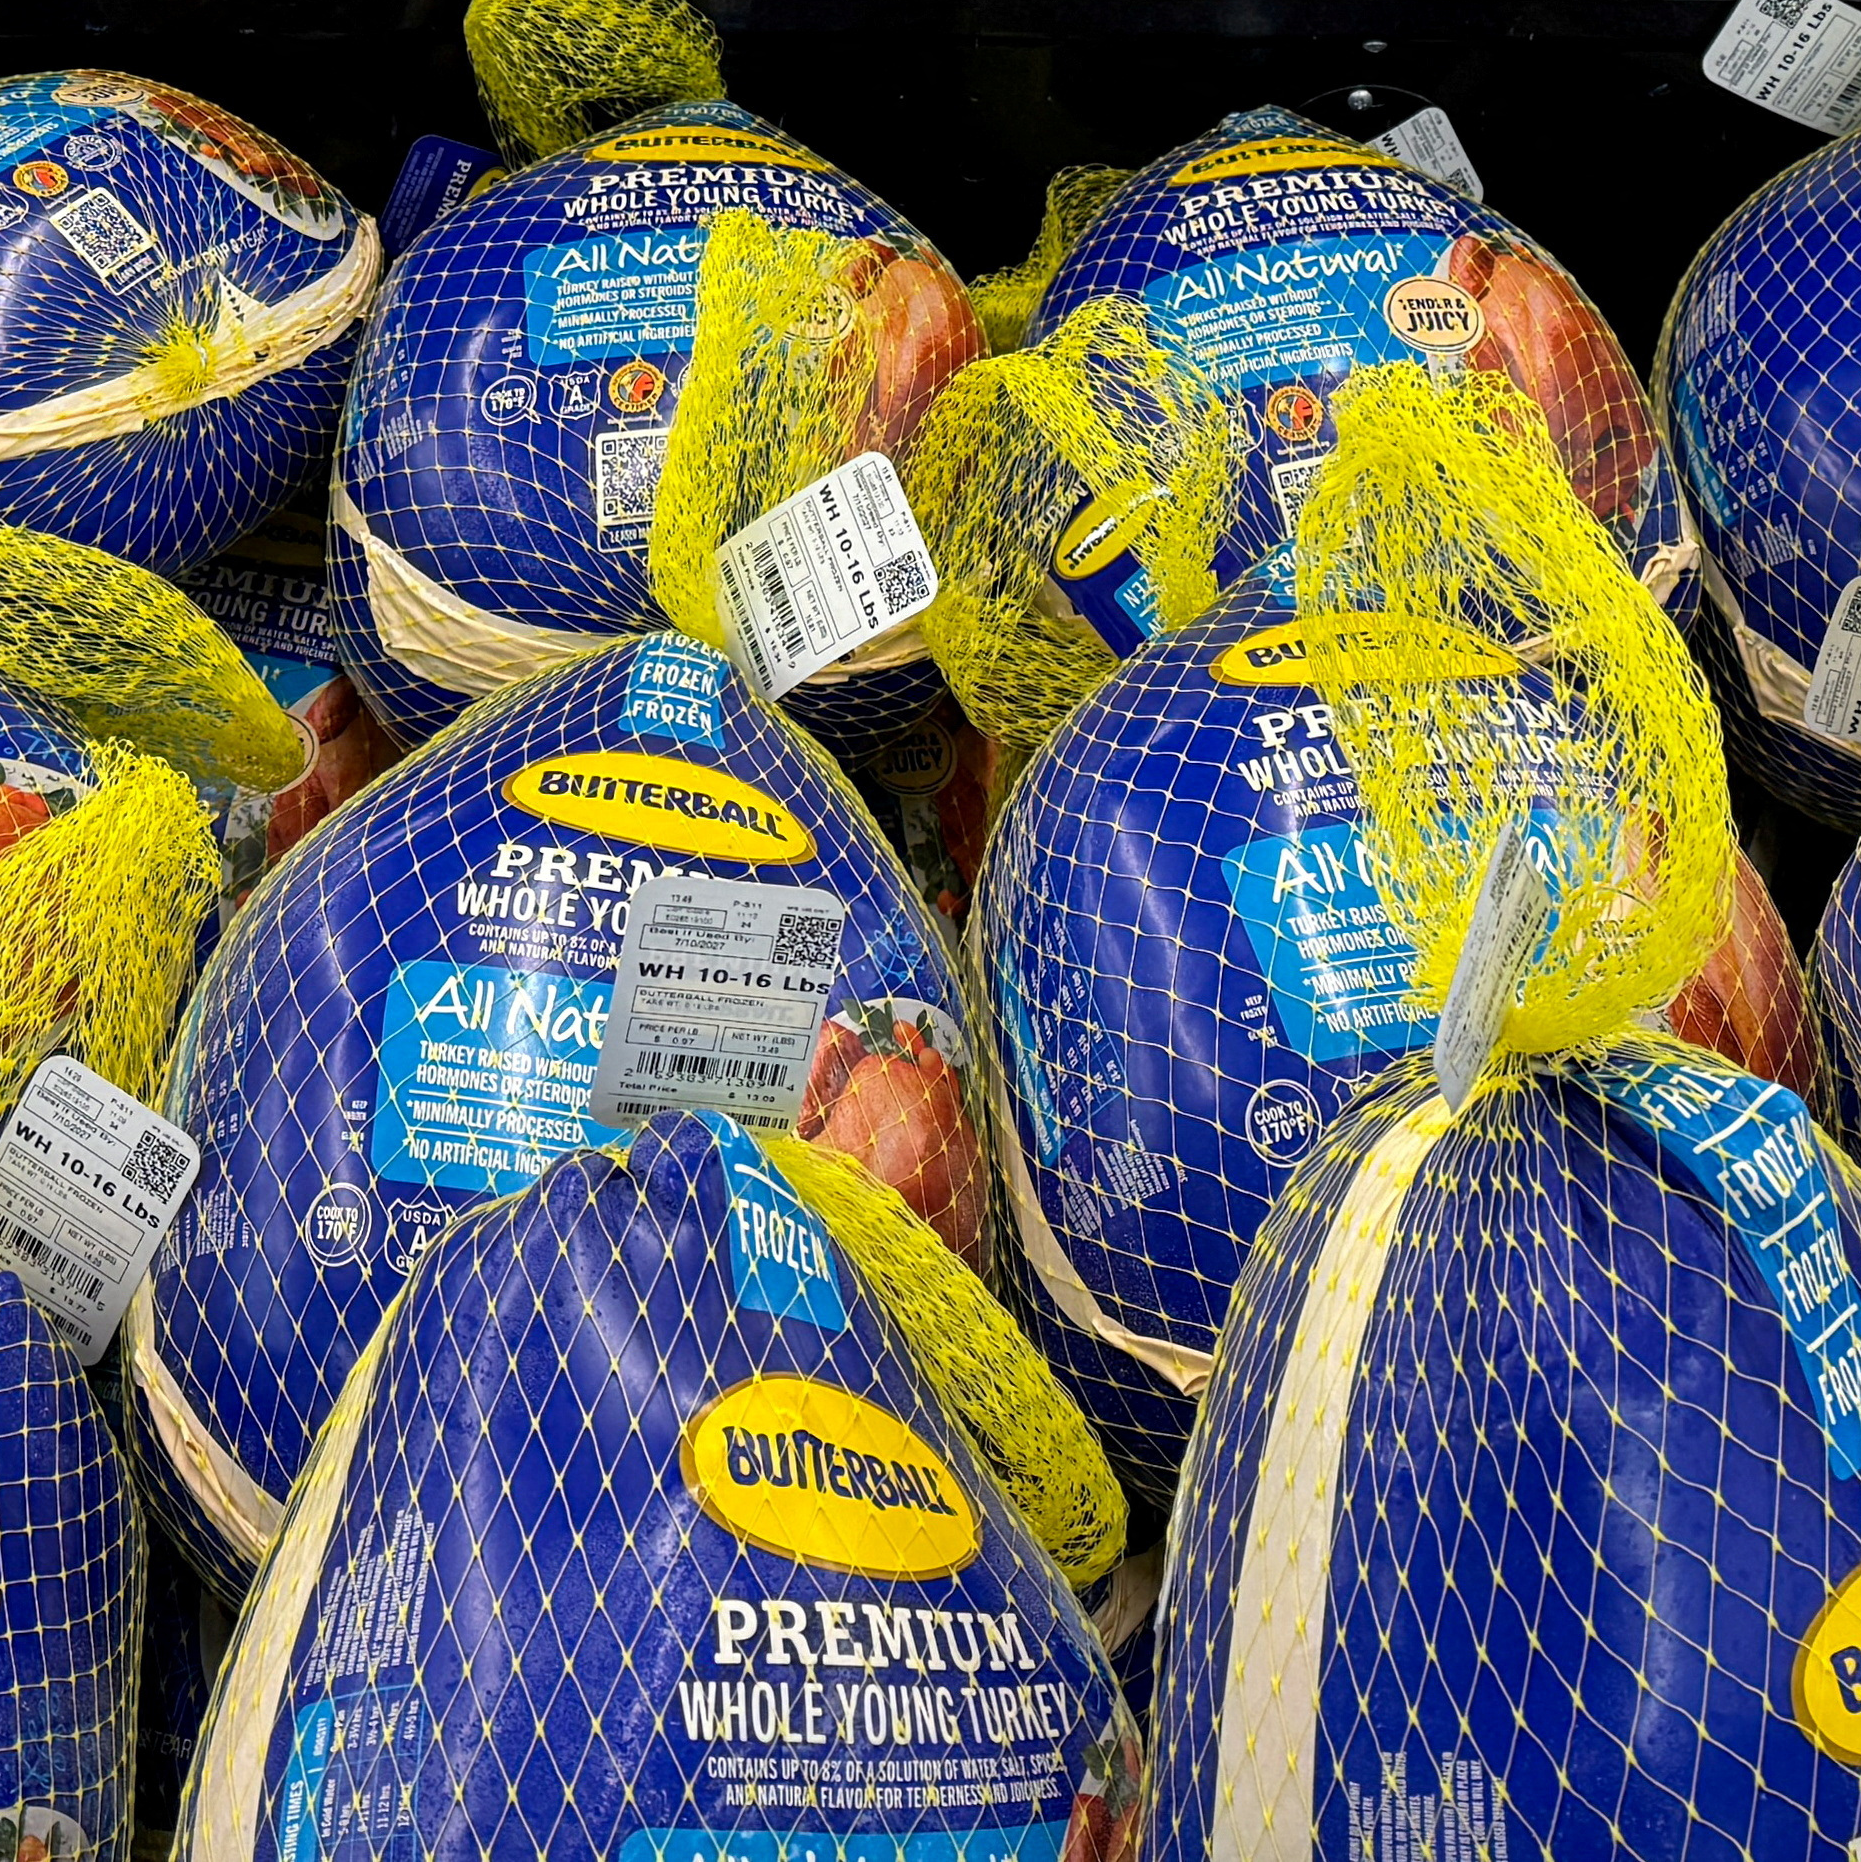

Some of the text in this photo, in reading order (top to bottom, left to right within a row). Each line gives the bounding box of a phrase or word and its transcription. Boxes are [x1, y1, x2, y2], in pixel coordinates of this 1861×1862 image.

[1754, 0, 1835, 103] WH 10-16 Lbs
[563, 186, 867, 222] WHOLE YOUNG TURKEY
[587, 168, 837, 195] PREMIUM
[1180, 172, 1429, 219] PREMIUM
[1164, 189, 1459, 247] WHOLE YOUNG TURKEY
[551, 245, 610, 278] All
[556, 271, 693, 295] TURKEY RAISED WITHOUT
[1171, 268, 1226, 310] All
[1406, 310, 1471, 334] JUICY
[817, 484, 880, 630] WH 10-16 Lbs
[639, 662, 713, 696] FROZEN
[631, 698, 712, 732] FROZEN
[538, 770, 787, 842] BUTTERBALL
[454, 881, 577, 931] WHOLE
[675, 937, 725, 951] 7/10/2027
[638, 962, 830, 995] WH 10-16 Lbs
[418, 982, 494, 1031] All
[13, 1119, 163, 1230] WH 10-16 Lbs
[1716, 1113, 1819, 1218] FROZEN
[740, 1197, 833, 1283] FROZEN
[1781, 1240, 1851, 1322] FROZEN
[726, 1426, 958, 1519] BUTTERBALL
[713, 1599, 1036, 1672] PREMIUM
[679, 1682, 1069, 1744] WHOLE YOUNG TURKEY
